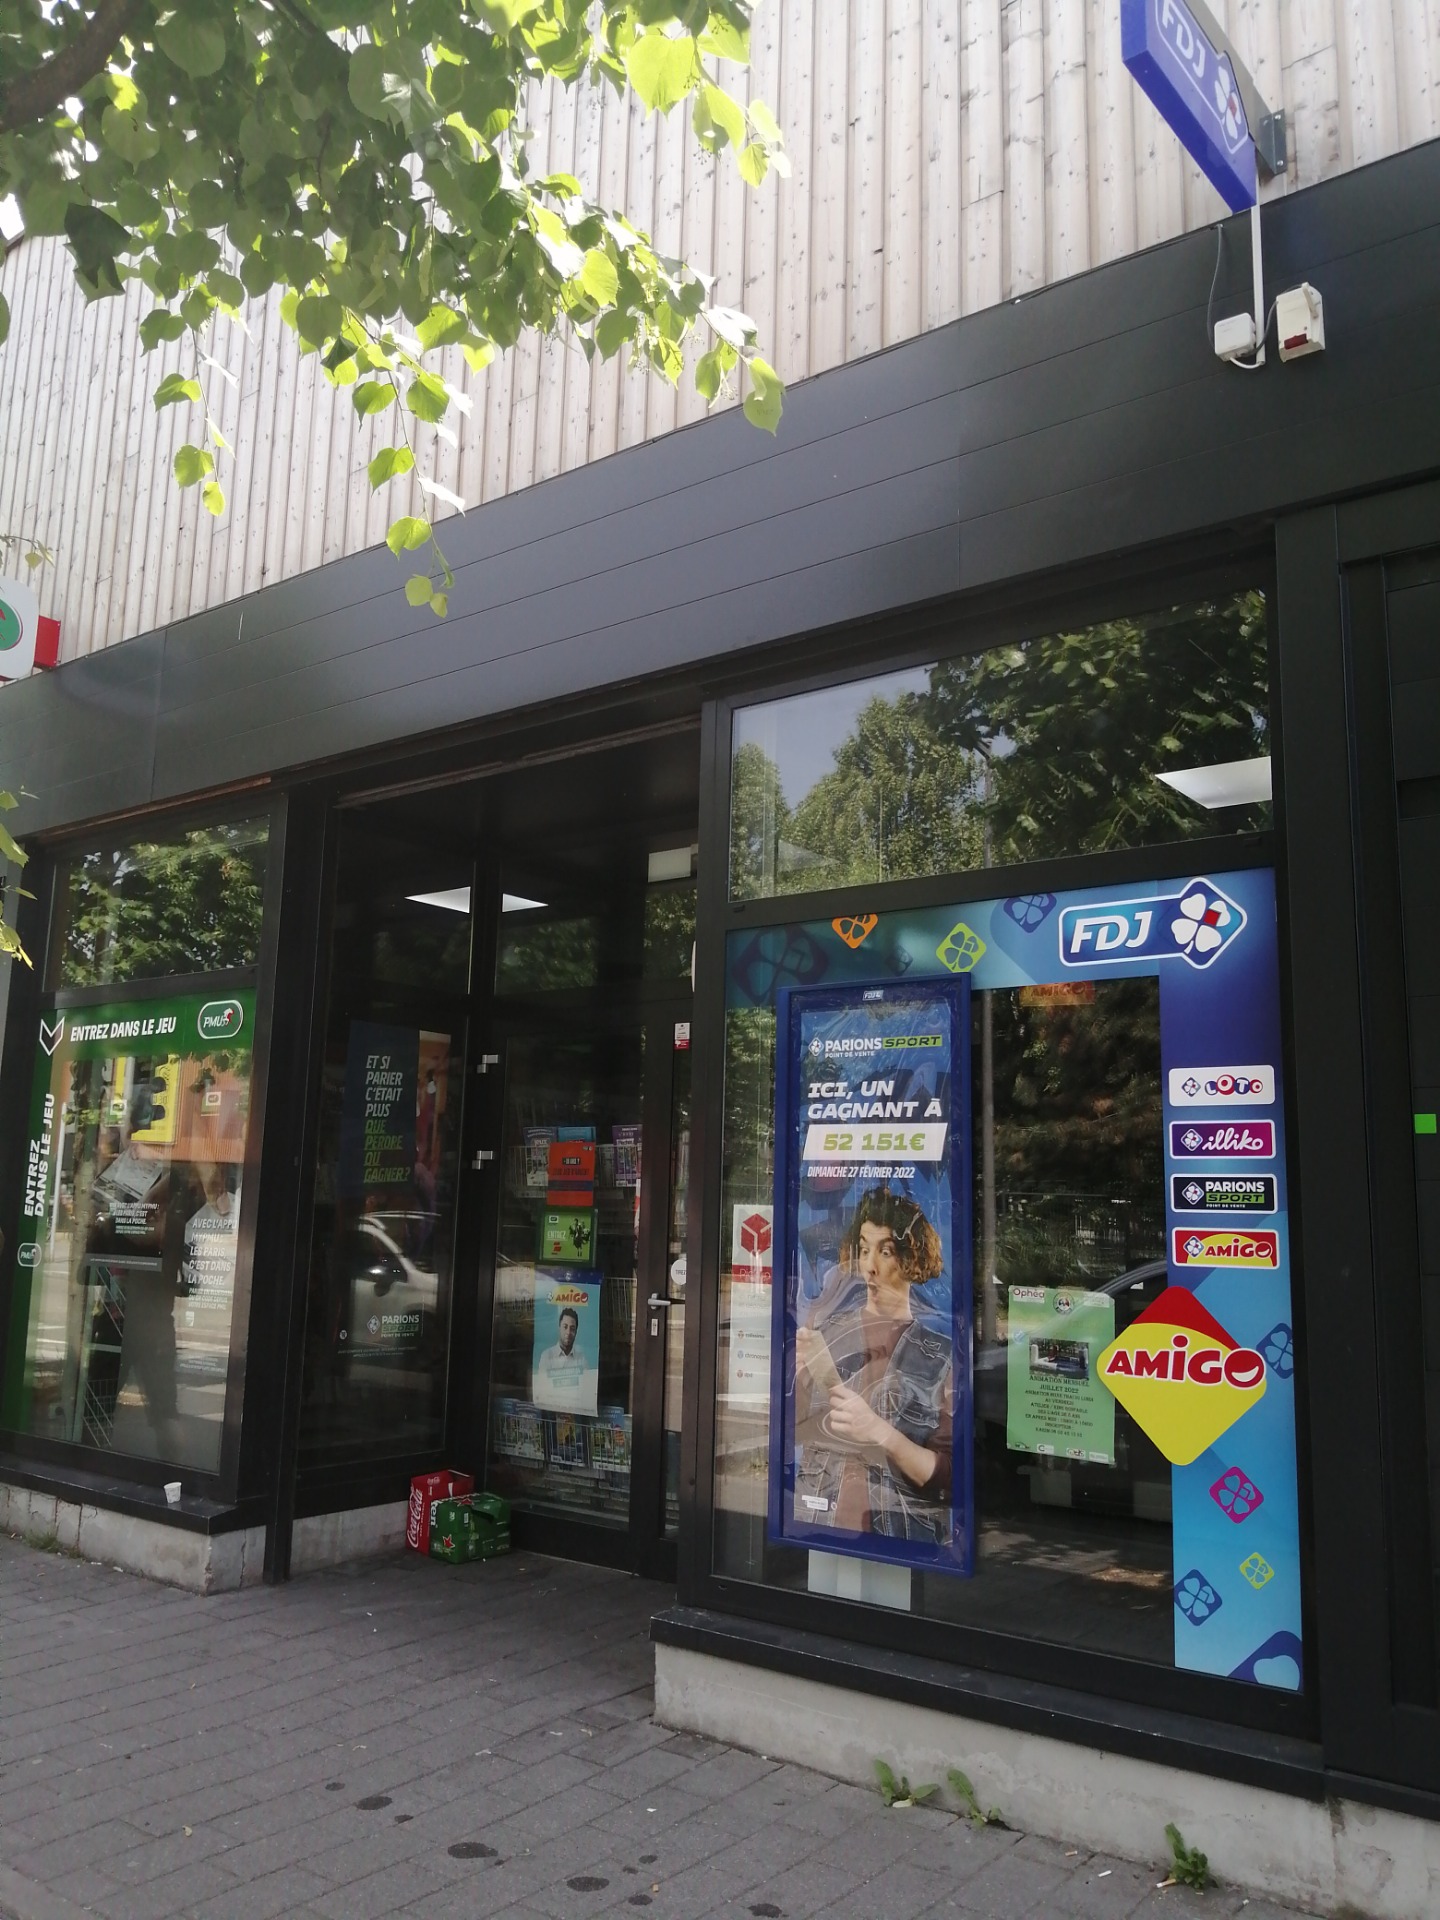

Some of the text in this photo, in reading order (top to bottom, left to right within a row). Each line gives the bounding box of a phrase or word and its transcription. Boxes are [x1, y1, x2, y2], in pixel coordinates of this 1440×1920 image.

[1162, 0, 1206, 79] FDJ
[1070, 910, 1153, 954] FDJ
[70, 1016, 177, 1042] ENTREZ DANS LE JEU
[203, 1016, 222, 1029] PMU
[825, 1036, 941, 1051] PARIONS SPORT
[366, 1055, 391, 1070] ET SI
[365, 1071, 403, 1085] PARIER
[1205, 1074, 1263, 1096] LOTO
[807, 1081, 895, 1100] ICI, UN
[365, 1103, 391, 1117] PLUS
[807, 1101, 919, 1120] GAGNANT
[365, 1119, 386, 1134] QUE
[365, 1135, 403, 1149] PERDRE
[823, 1133, 926, 1151] 52 151€
[1202, 1127, 1264, 1151] illiko
[34, 1093, 55, 1218] DANS LE JEU
[365, 1151, 381, 1165] OU
[23, 1139, 40, 1217] ENTREZ
[807, 1164, 915, 1178] DIMANCHE 27 FÉVRIER 2022
[1205, 1181, 1265, 1193] PARIONS
[1208, 1193, 1263, 1203] SPORT
[192, 1218, 212, 1229] AVEC
[190, 1246, 202, 1256] LES
[1205, 1237, 1273, 1259] AMIGO
[189, 1260, 231, 1272] C'EST DANS
[188, 1274, 197, 1284] LA
[555, 1288, 589, 1304] AMIGO
[381, 1315, 420, 1324] PARIONS
[382, 1324, 418, 1332] SPORT
[1105, 1334, 1266, 1388] AMIGO
[1029, 1375, 1062, 1384] ANIMATION
[1040, 1384, 1063, 1392] JUILLET
